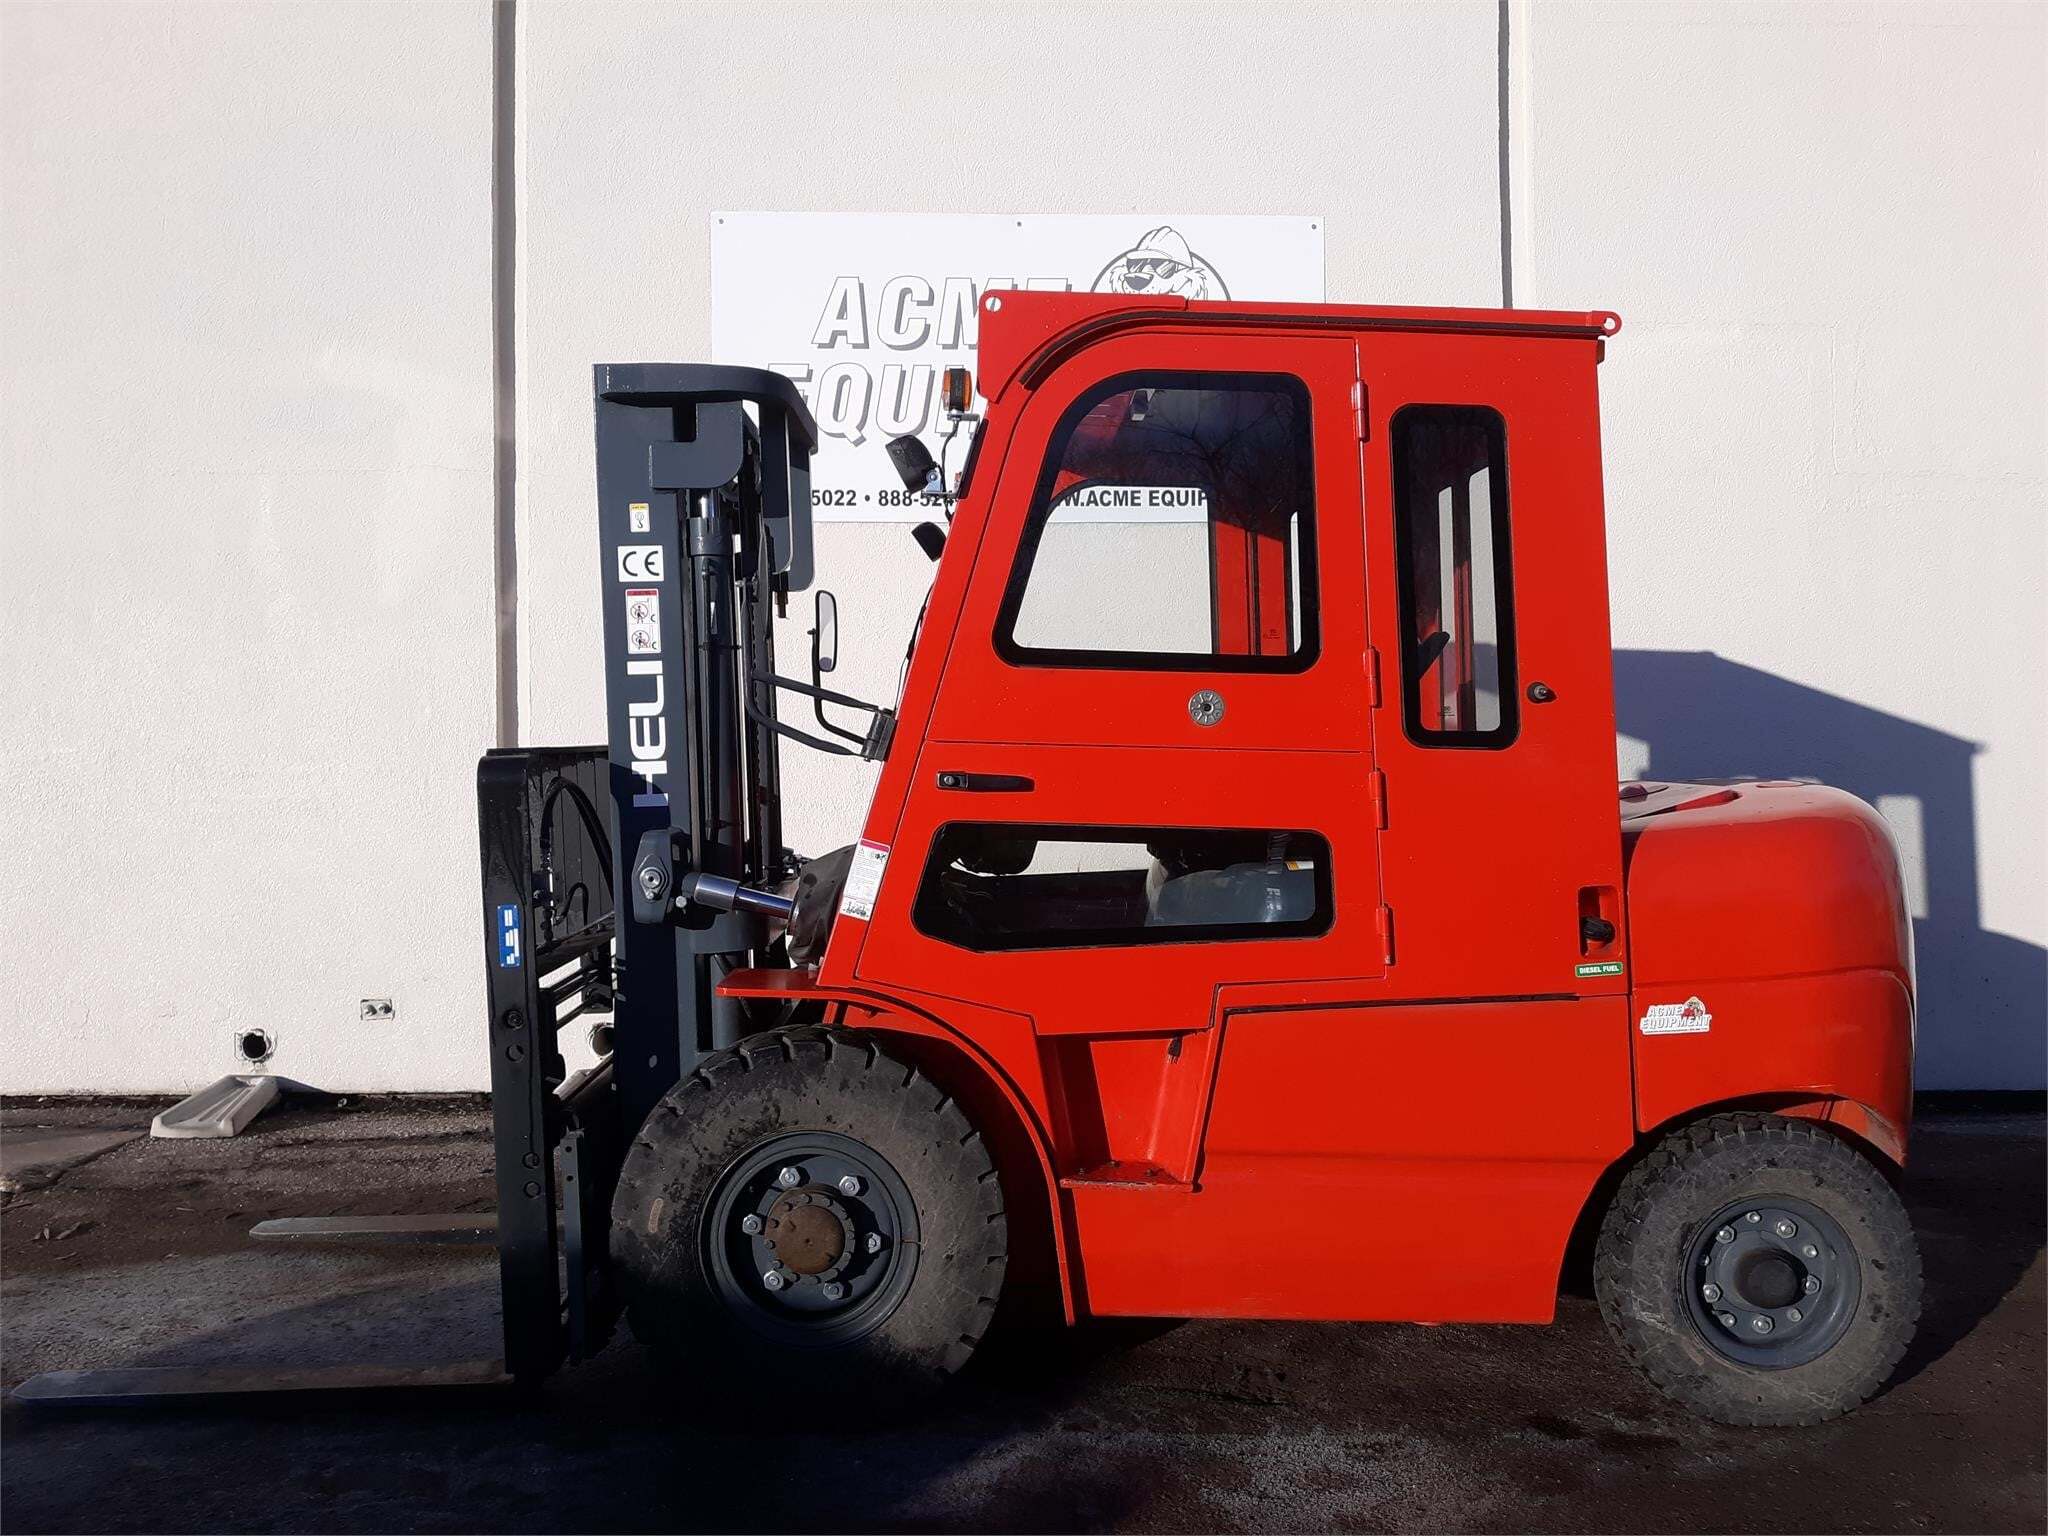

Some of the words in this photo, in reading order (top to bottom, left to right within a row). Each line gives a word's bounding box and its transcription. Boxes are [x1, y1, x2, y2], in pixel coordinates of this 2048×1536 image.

[811, 275, 1072, 350] ACM
[811, 489, 857, 507] 5022
[622, 550, 660, 577] CE
[626, 660, 669, 808] HELI
[1579, 966, 1602, 975] DIESEL
[1602, 964, 1619, 972] FUEL
[1648, 1005, 1683, 1018] ACME
[1642, 1014, 1710, 1030] EQUIPMENT
